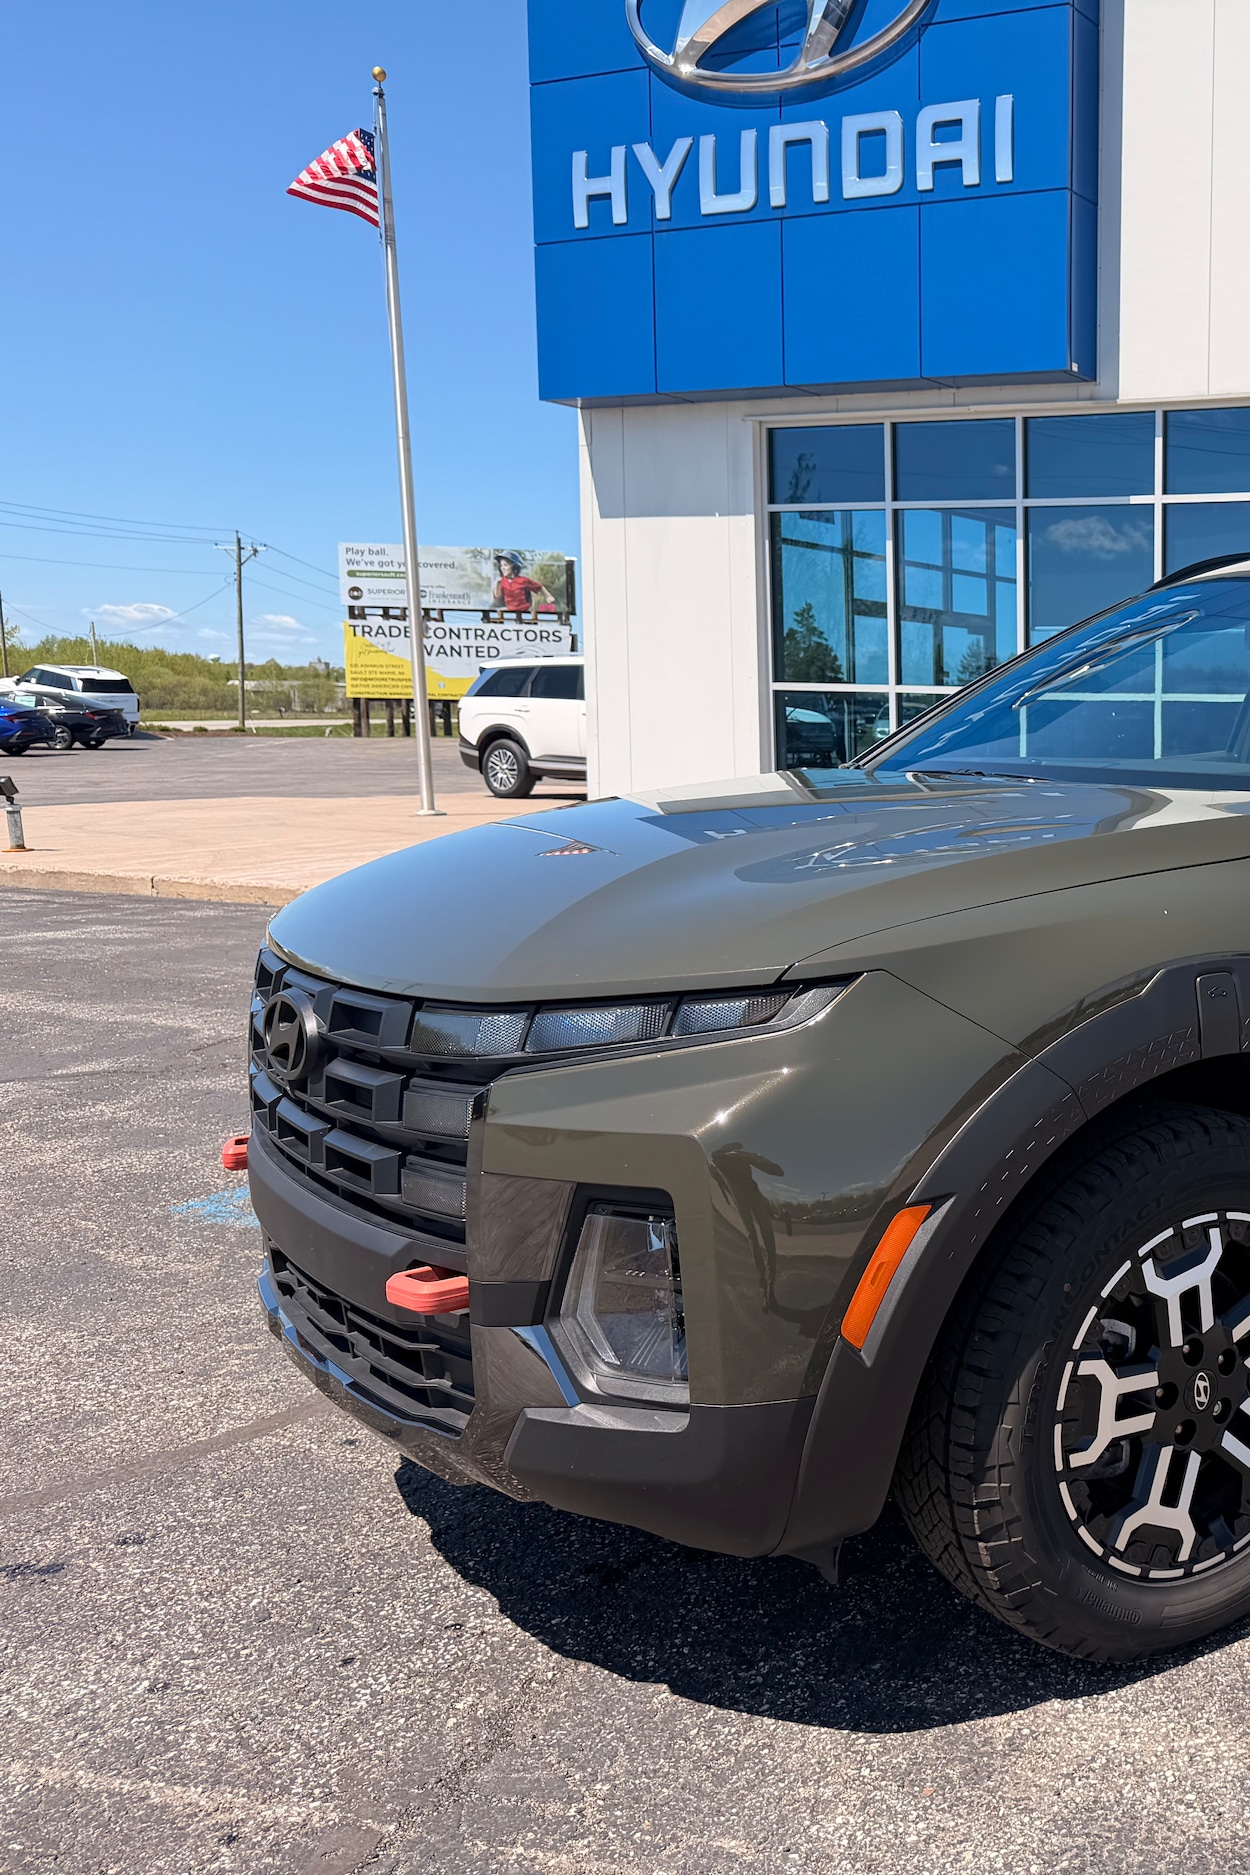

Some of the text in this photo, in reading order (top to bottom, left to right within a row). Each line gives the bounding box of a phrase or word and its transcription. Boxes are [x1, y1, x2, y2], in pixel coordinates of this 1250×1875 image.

[571, 94, 1014, 229] HYUNDAI
[345, 547, 389, 557] Play ball.
[346, 558, 375, 567] We've
[377, 560, 395, 568] got
[348, 624, 411, 638] TRADE
